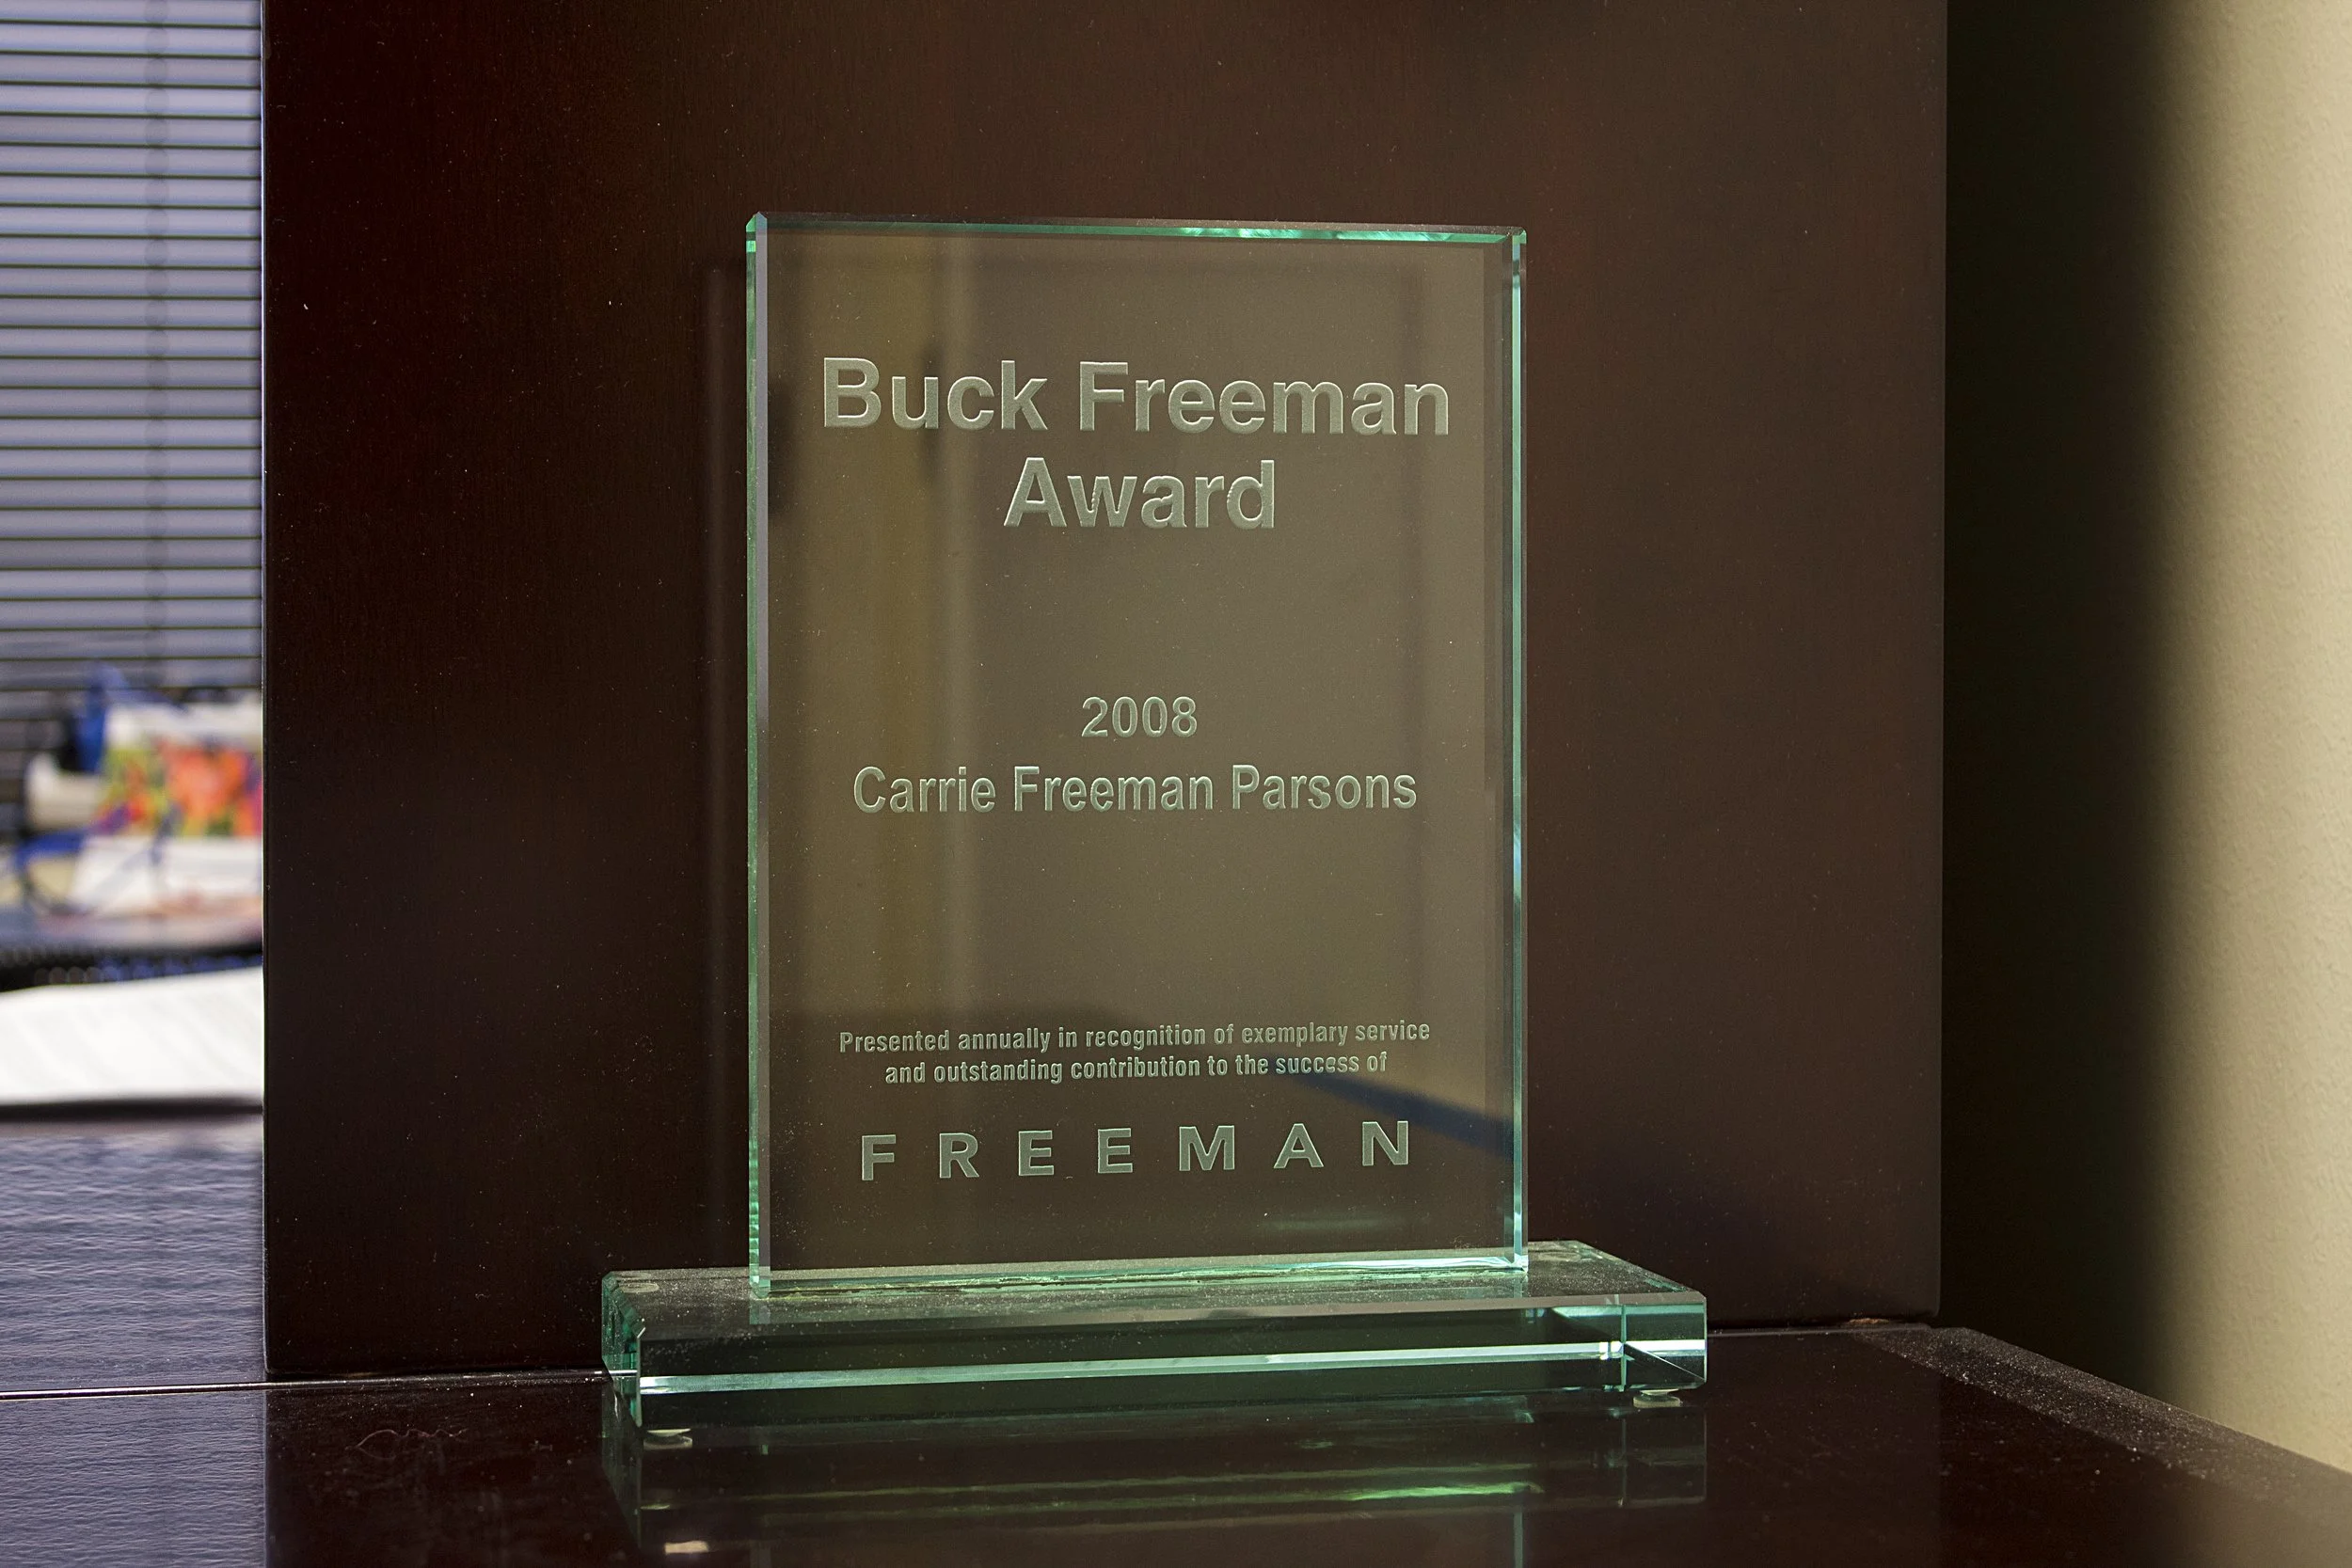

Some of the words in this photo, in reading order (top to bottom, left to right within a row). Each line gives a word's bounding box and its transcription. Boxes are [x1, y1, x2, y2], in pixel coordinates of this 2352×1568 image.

[823, 356, 1047, 431] Buck
[1079, 361, 1449, 436] Freeman
[1003, 456, 1275, 528] Award
[1081, 696, 1199, 738] 2008
[853, 766, 996, 813] Carrie
[1014, 765, 1214, 812] Freeman
[1232, 764, 1418, 810] Parsons
[838, 1029, 950, 1053] Presented
[958, 1025, 1052, 1052] annually
[1058, 1027, 1078, 1048] in
[1086, 1024, 1208, 1050] recognition
[1214, 1023, 1234, 1045] of
[1242, 1022, 1349, 1047] exemplary
[1355, 1021, 1431, 1042] service
[884, 1062, 927, 1085] and
[933, 1059, 1063, 1084] outstanding
[1070, 1055, 1201, 1080] contribution
[1207, 1056, 1228, 1076] to
[1234, 1053, 1270, 1076] the
[1276, 1054, 1360, 1074] success
[1367, 1052, 1388, 1072] of
[861, 1120, 1410, 1181] FREEMAN
